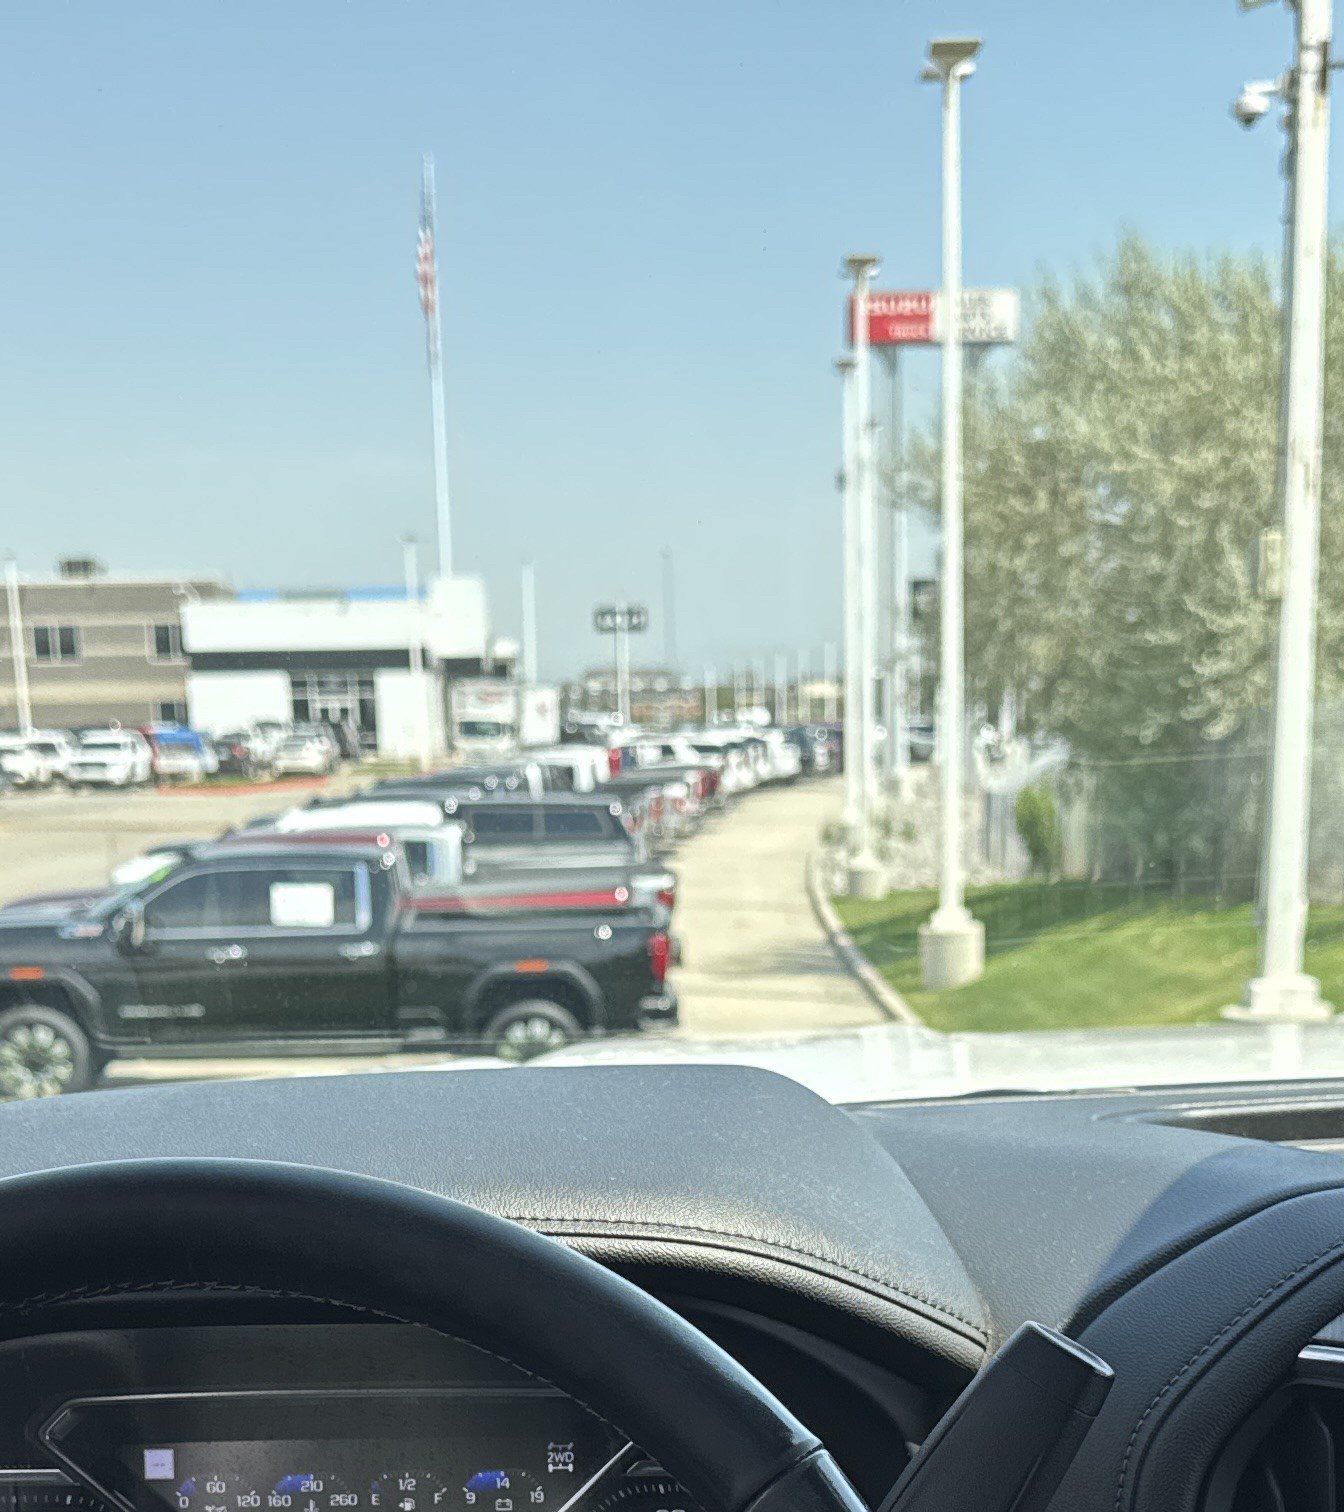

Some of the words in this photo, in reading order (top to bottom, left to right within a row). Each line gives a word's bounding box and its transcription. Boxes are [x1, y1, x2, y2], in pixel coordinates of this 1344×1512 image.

[547, 1451, 575, 1463] 2WD
[206, 1481, 226, 1494] 60
[300, 1480, 324, 1492] 210
[398, 1478, 417, 1491] 1/2
[496, 1477, 510, 1489] 14
[179, 1497, 189, 1509] 0
[237, 1494, 261, 1507] 120
[268, 1494, 292, 1507] 160
[330, 1493, 358, 1506] 260
[371, 1494, 380, 1506] E
[434, 1492, 443, 1504] F
[466, 1492, 476, 1504] 9
[530, 1491, 545, 1503] 19
